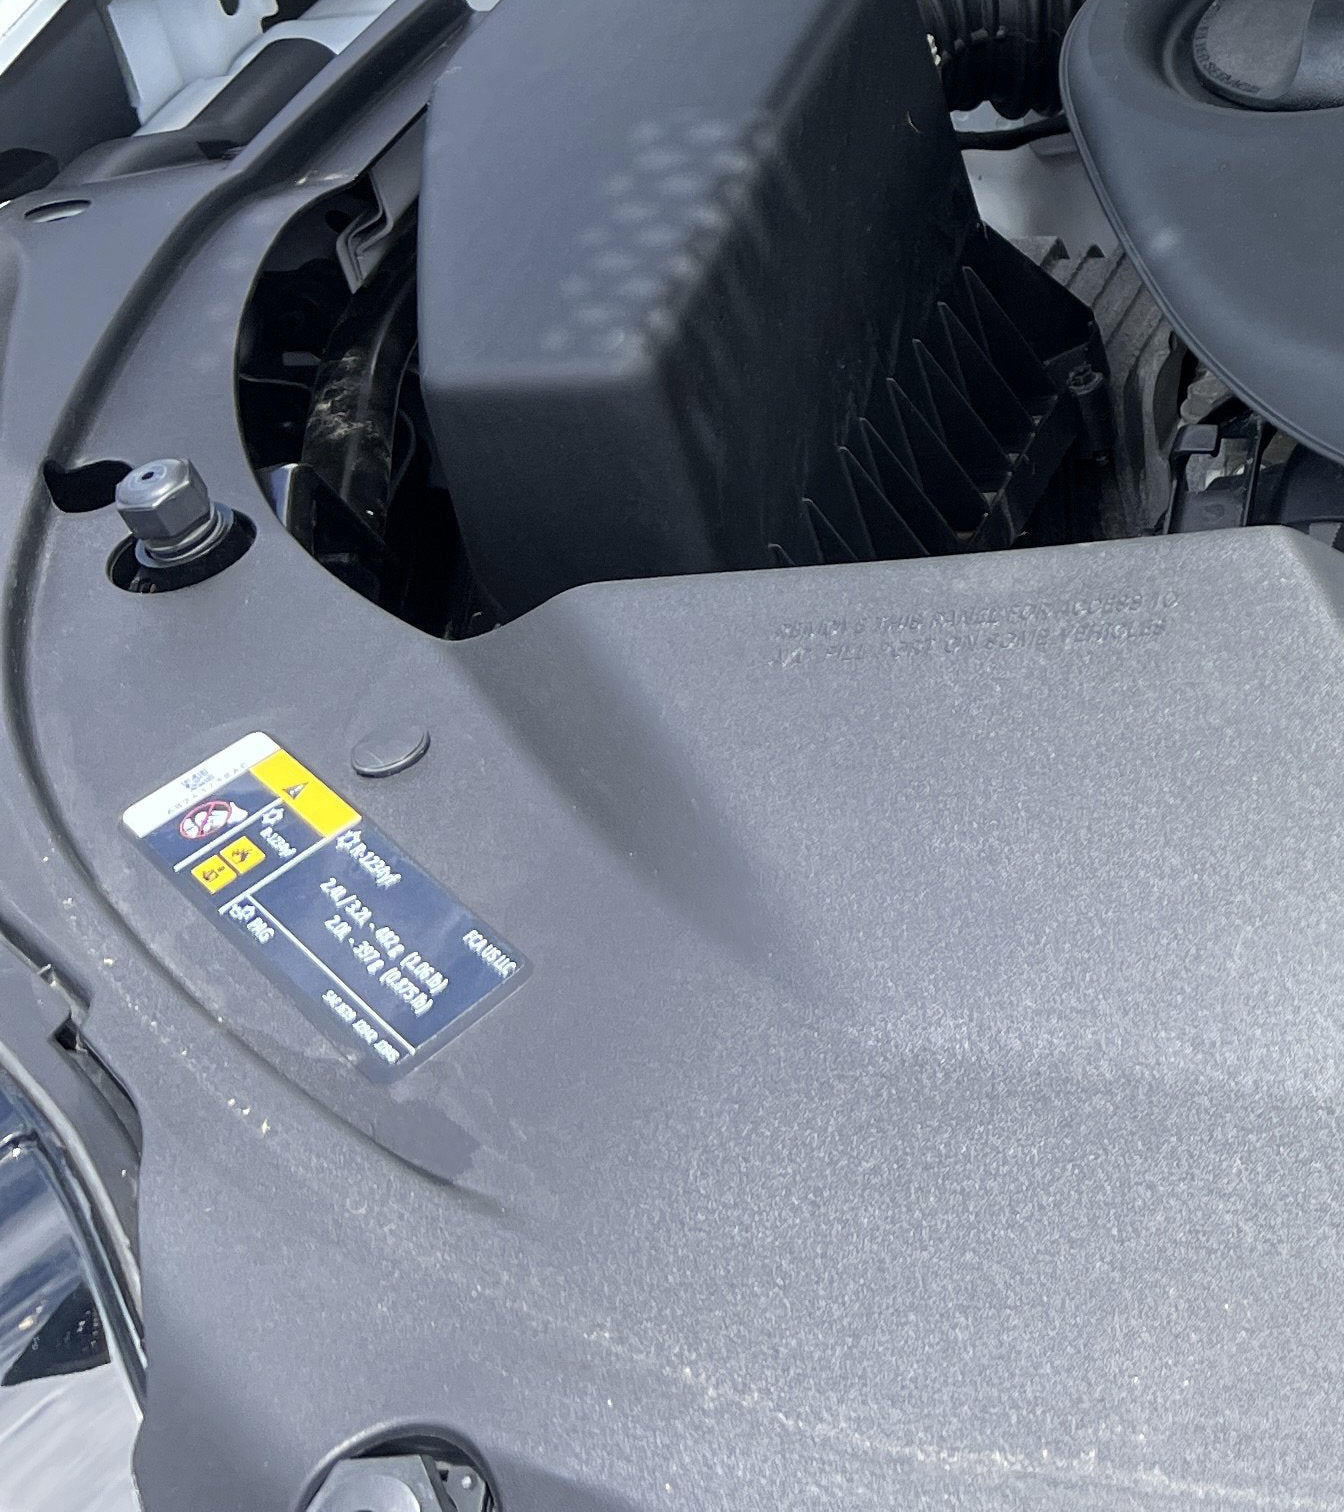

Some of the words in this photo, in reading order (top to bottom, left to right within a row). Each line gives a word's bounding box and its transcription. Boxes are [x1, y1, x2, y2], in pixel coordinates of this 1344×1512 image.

[246, 916, 275, 945] PAG
[462, 929, 488, 955] FCA
[481, 943, 502, 966] US
[494, 954, 517, 978] LLC
